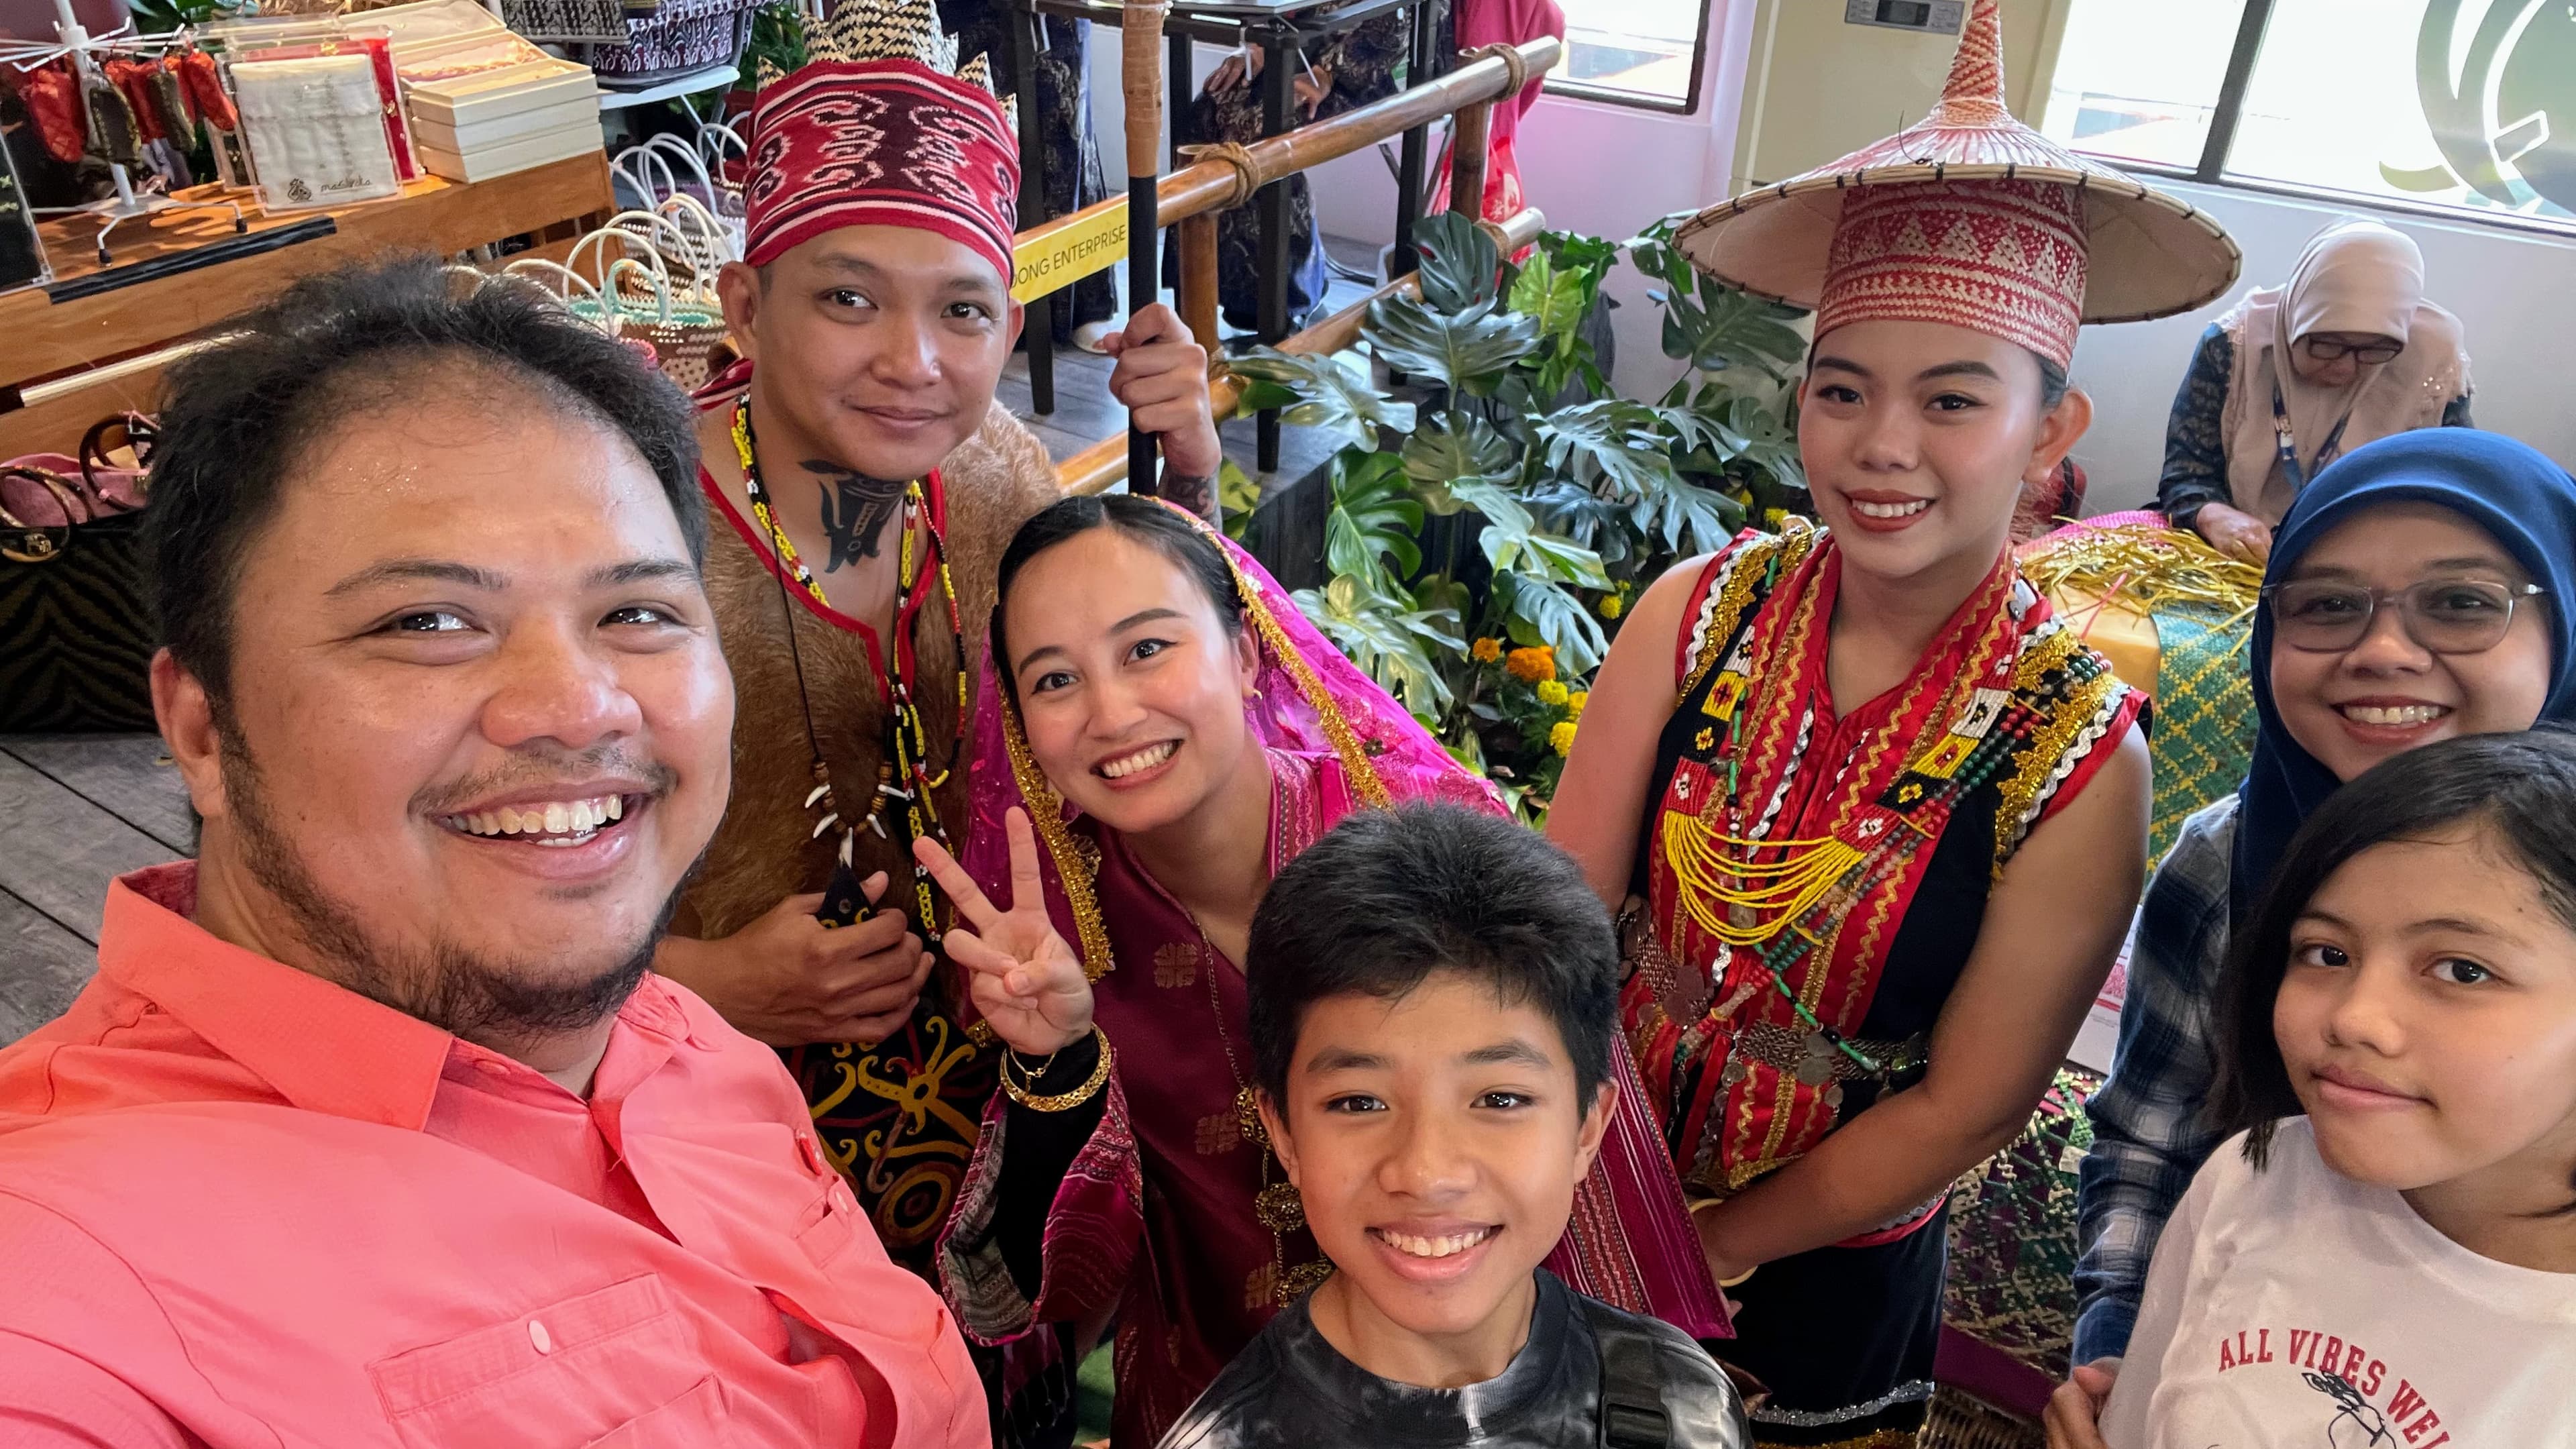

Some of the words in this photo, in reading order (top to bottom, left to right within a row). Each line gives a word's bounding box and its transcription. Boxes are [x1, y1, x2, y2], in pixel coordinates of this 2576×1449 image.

[1053, 224, 1126, 270] ENTERPRISE
[2218, 1328, 2273, 1373] ALL
[2289, 1328, 2387, 1397] VIBES
